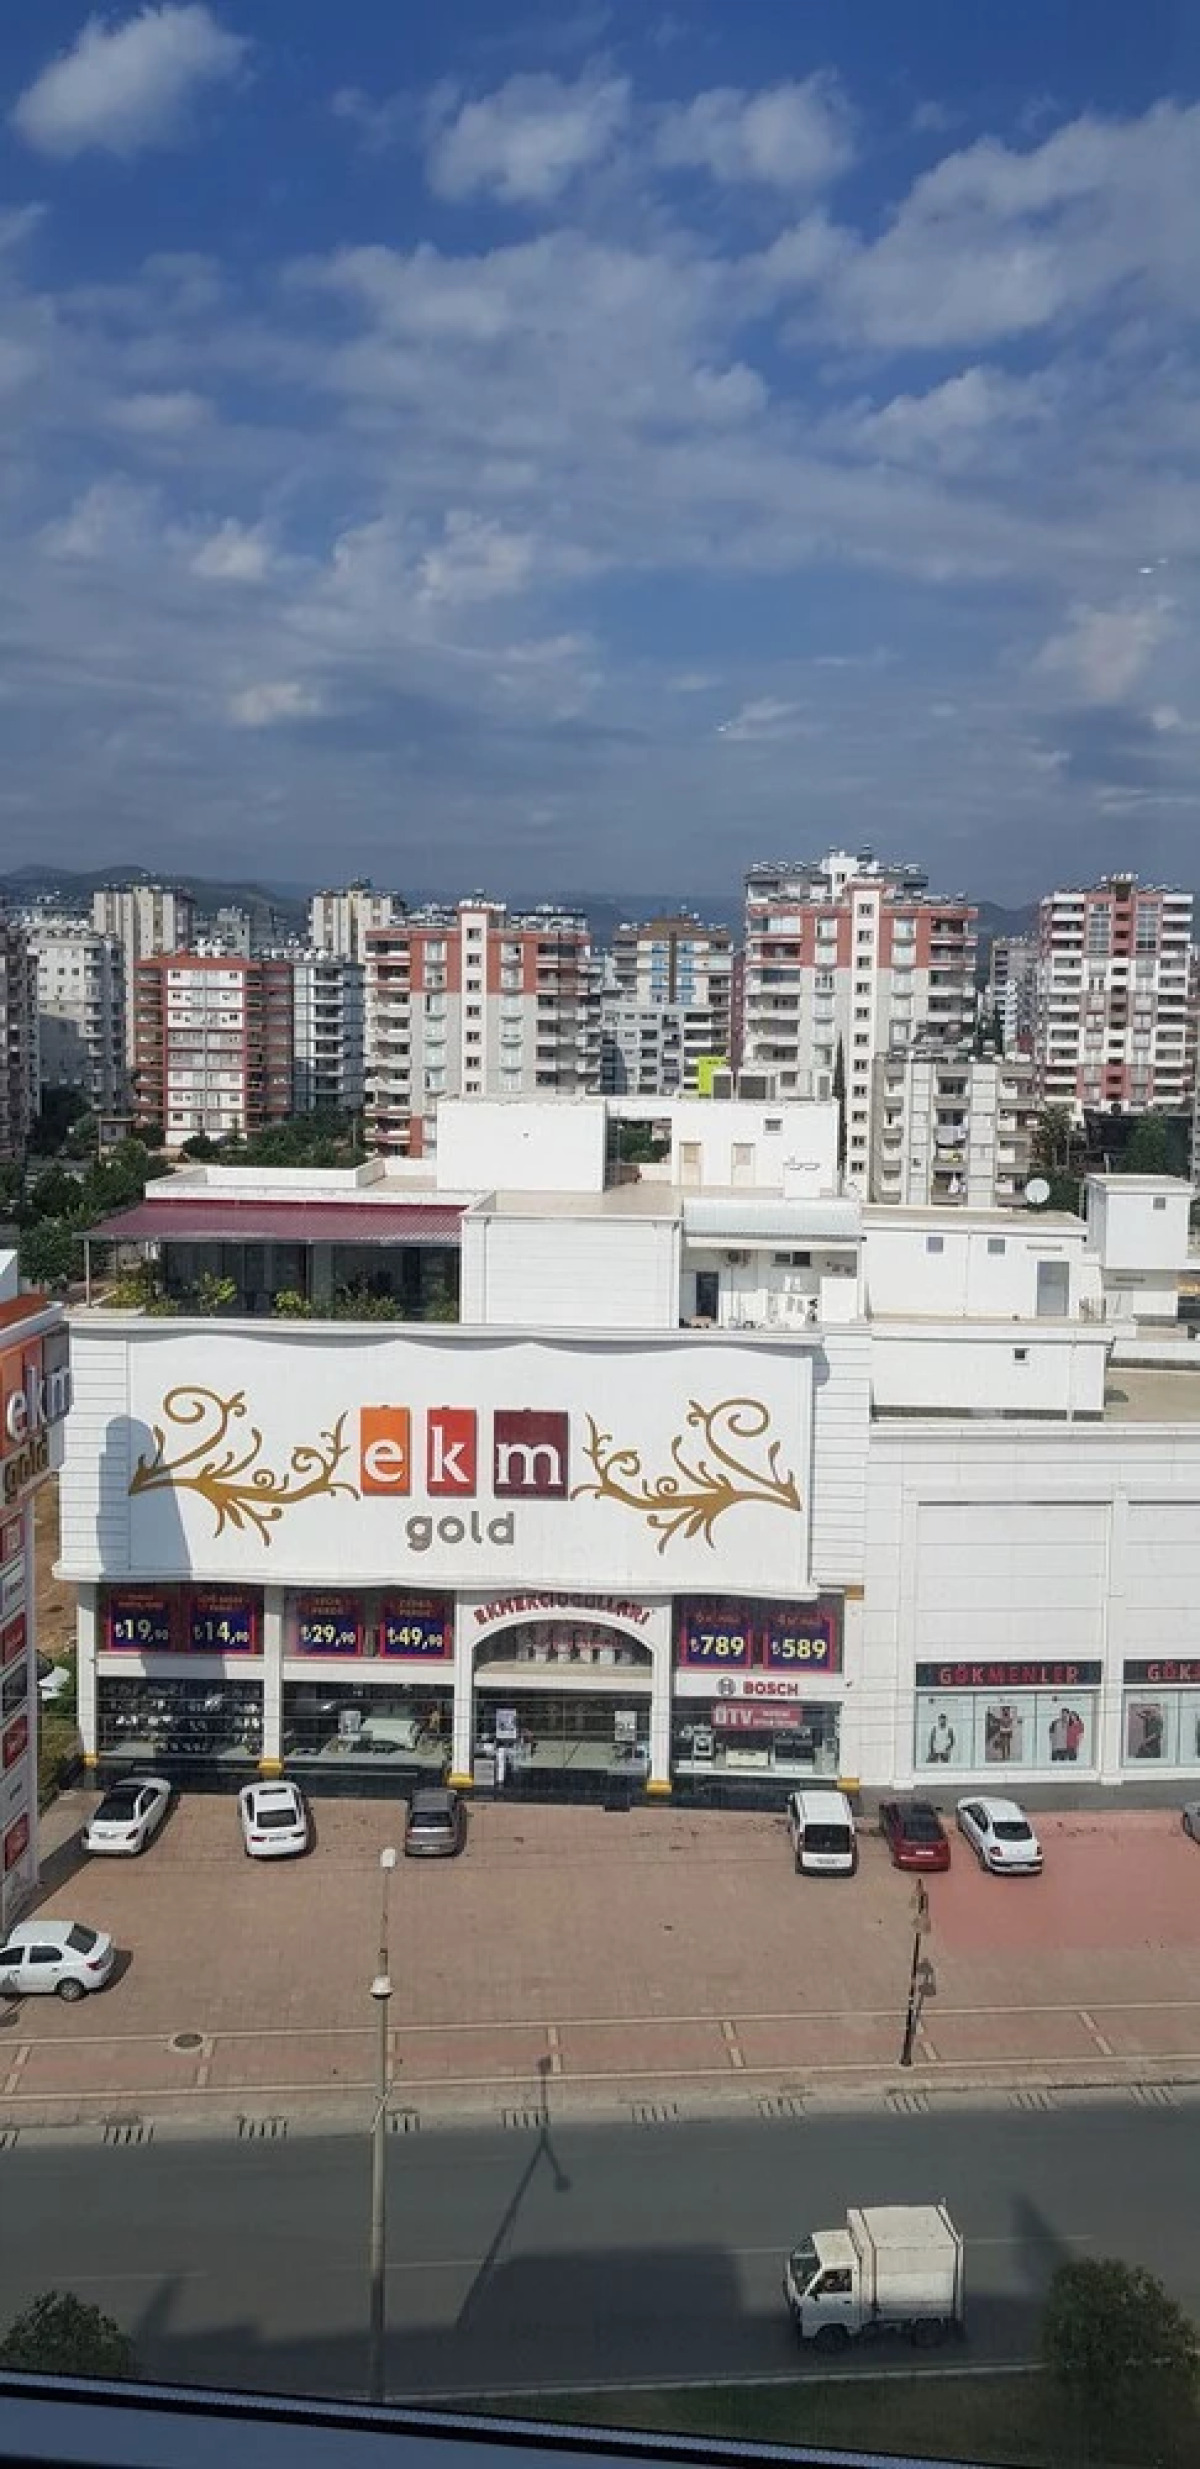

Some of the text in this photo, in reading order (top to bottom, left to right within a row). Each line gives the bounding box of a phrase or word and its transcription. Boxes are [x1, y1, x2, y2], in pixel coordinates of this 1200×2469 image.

[7, 1364, 70, 1443] ekm
[363, 1424, 564, 1485] ekm
[405, 1510, 515, 1552] gold
[743, 1681, 799, 1697] BOSCH
[938, 1664, 1080, 1685] GÖKMENLER
